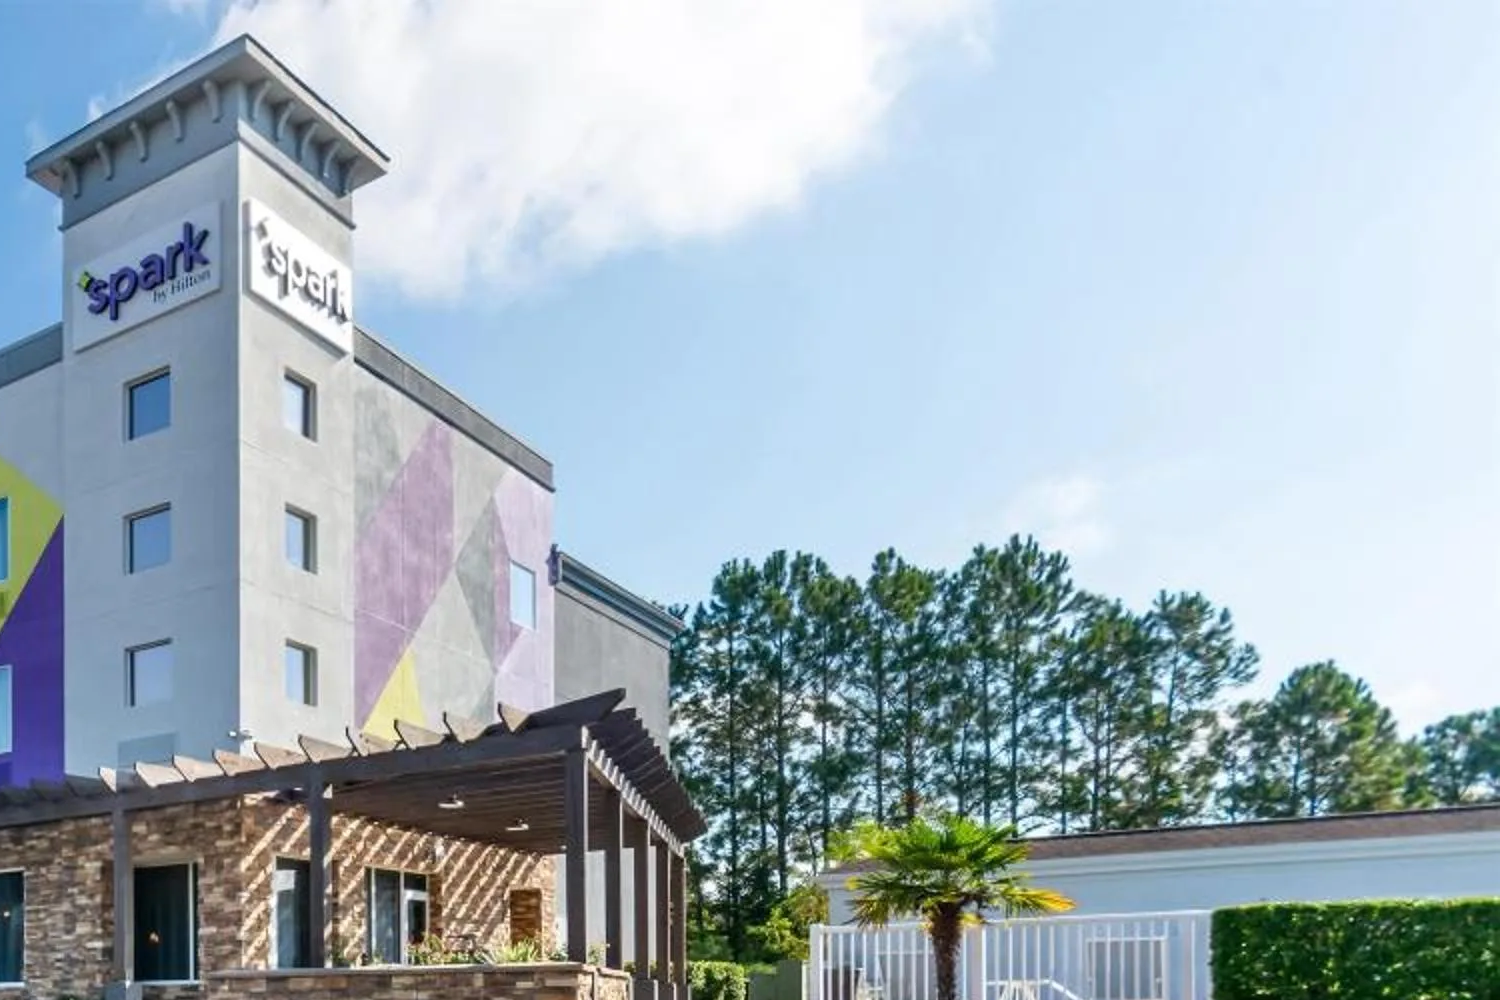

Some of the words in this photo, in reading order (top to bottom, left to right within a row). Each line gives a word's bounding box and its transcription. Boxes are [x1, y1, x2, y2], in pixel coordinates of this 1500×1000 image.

[87, 221, 211, 321] spark
[152, 289, 168, 304] by
[171, 269, 212, 295] Hilton
